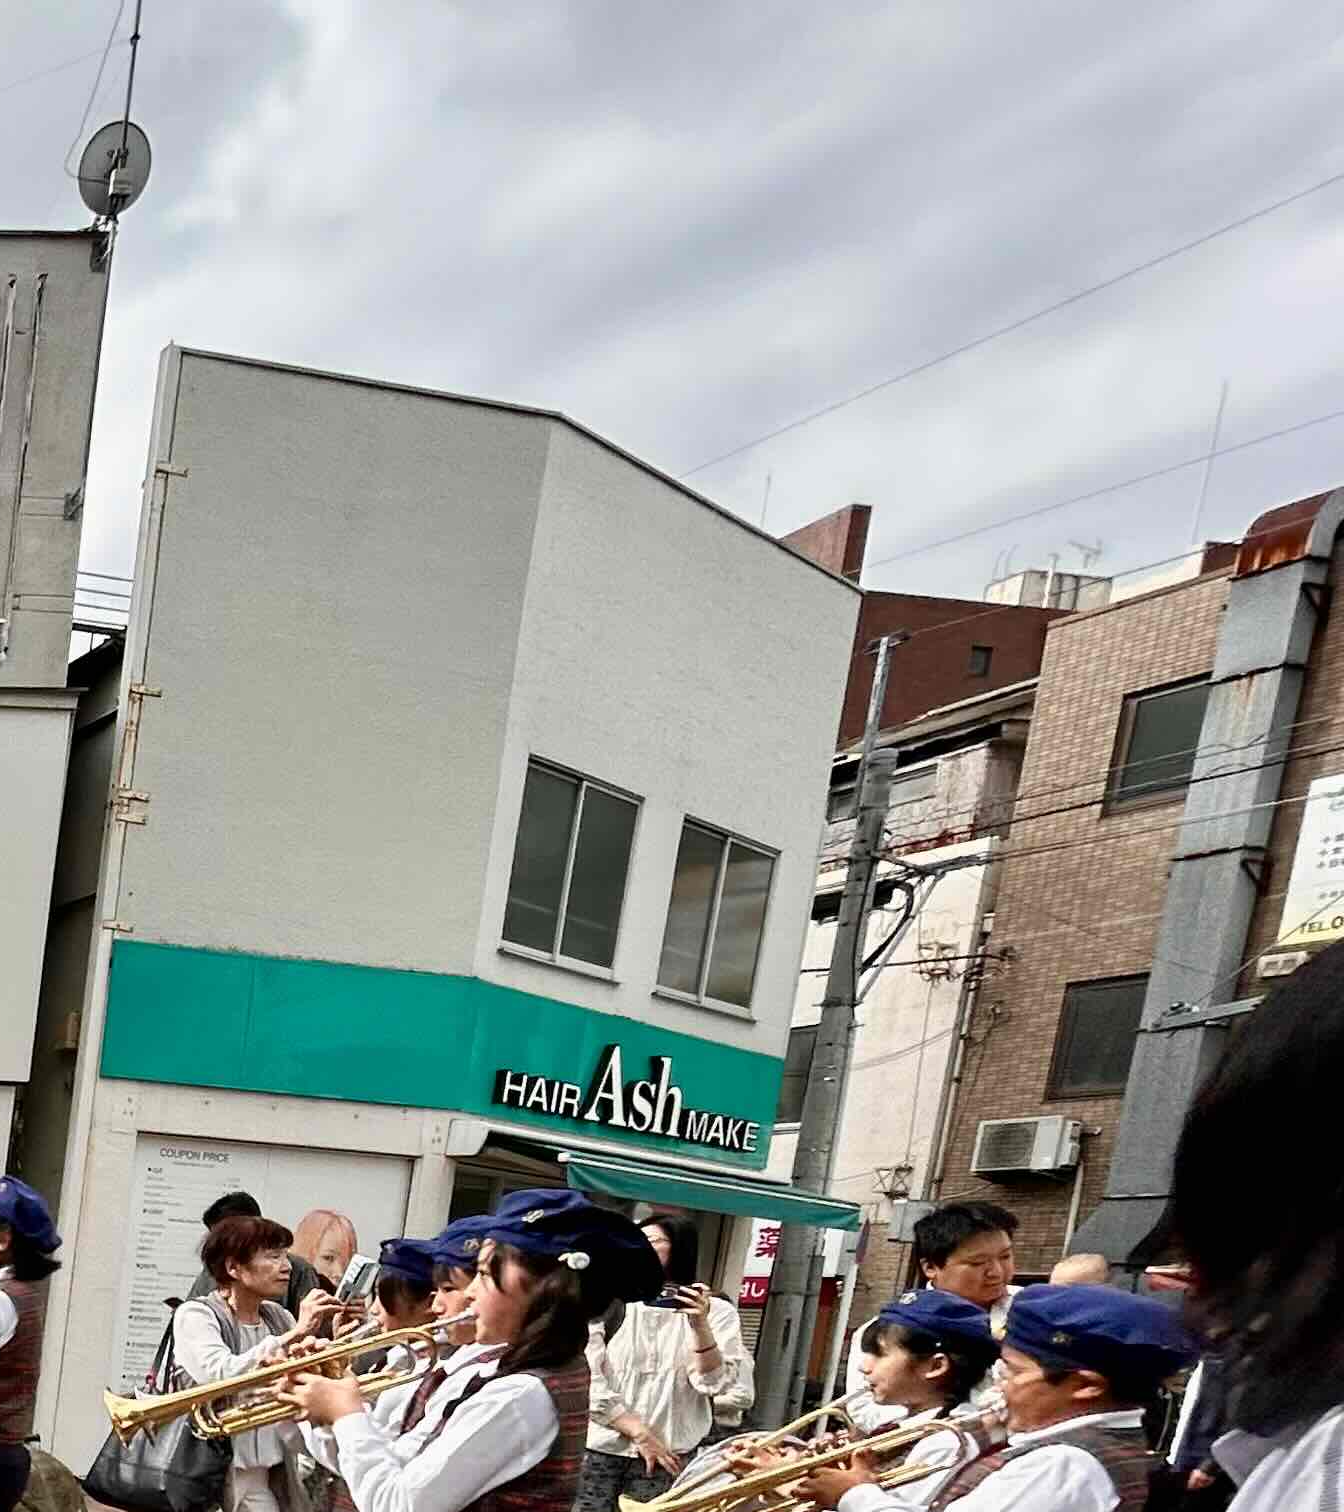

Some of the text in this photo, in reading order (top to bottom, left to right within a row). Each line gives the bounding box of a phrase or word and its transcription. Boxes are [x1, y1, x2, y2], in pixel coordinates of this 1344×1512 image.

[501, 1045, 760, 1152] HAIR Ash MAKE
[160, 1148, 230, 1163] COUPON PRICE
